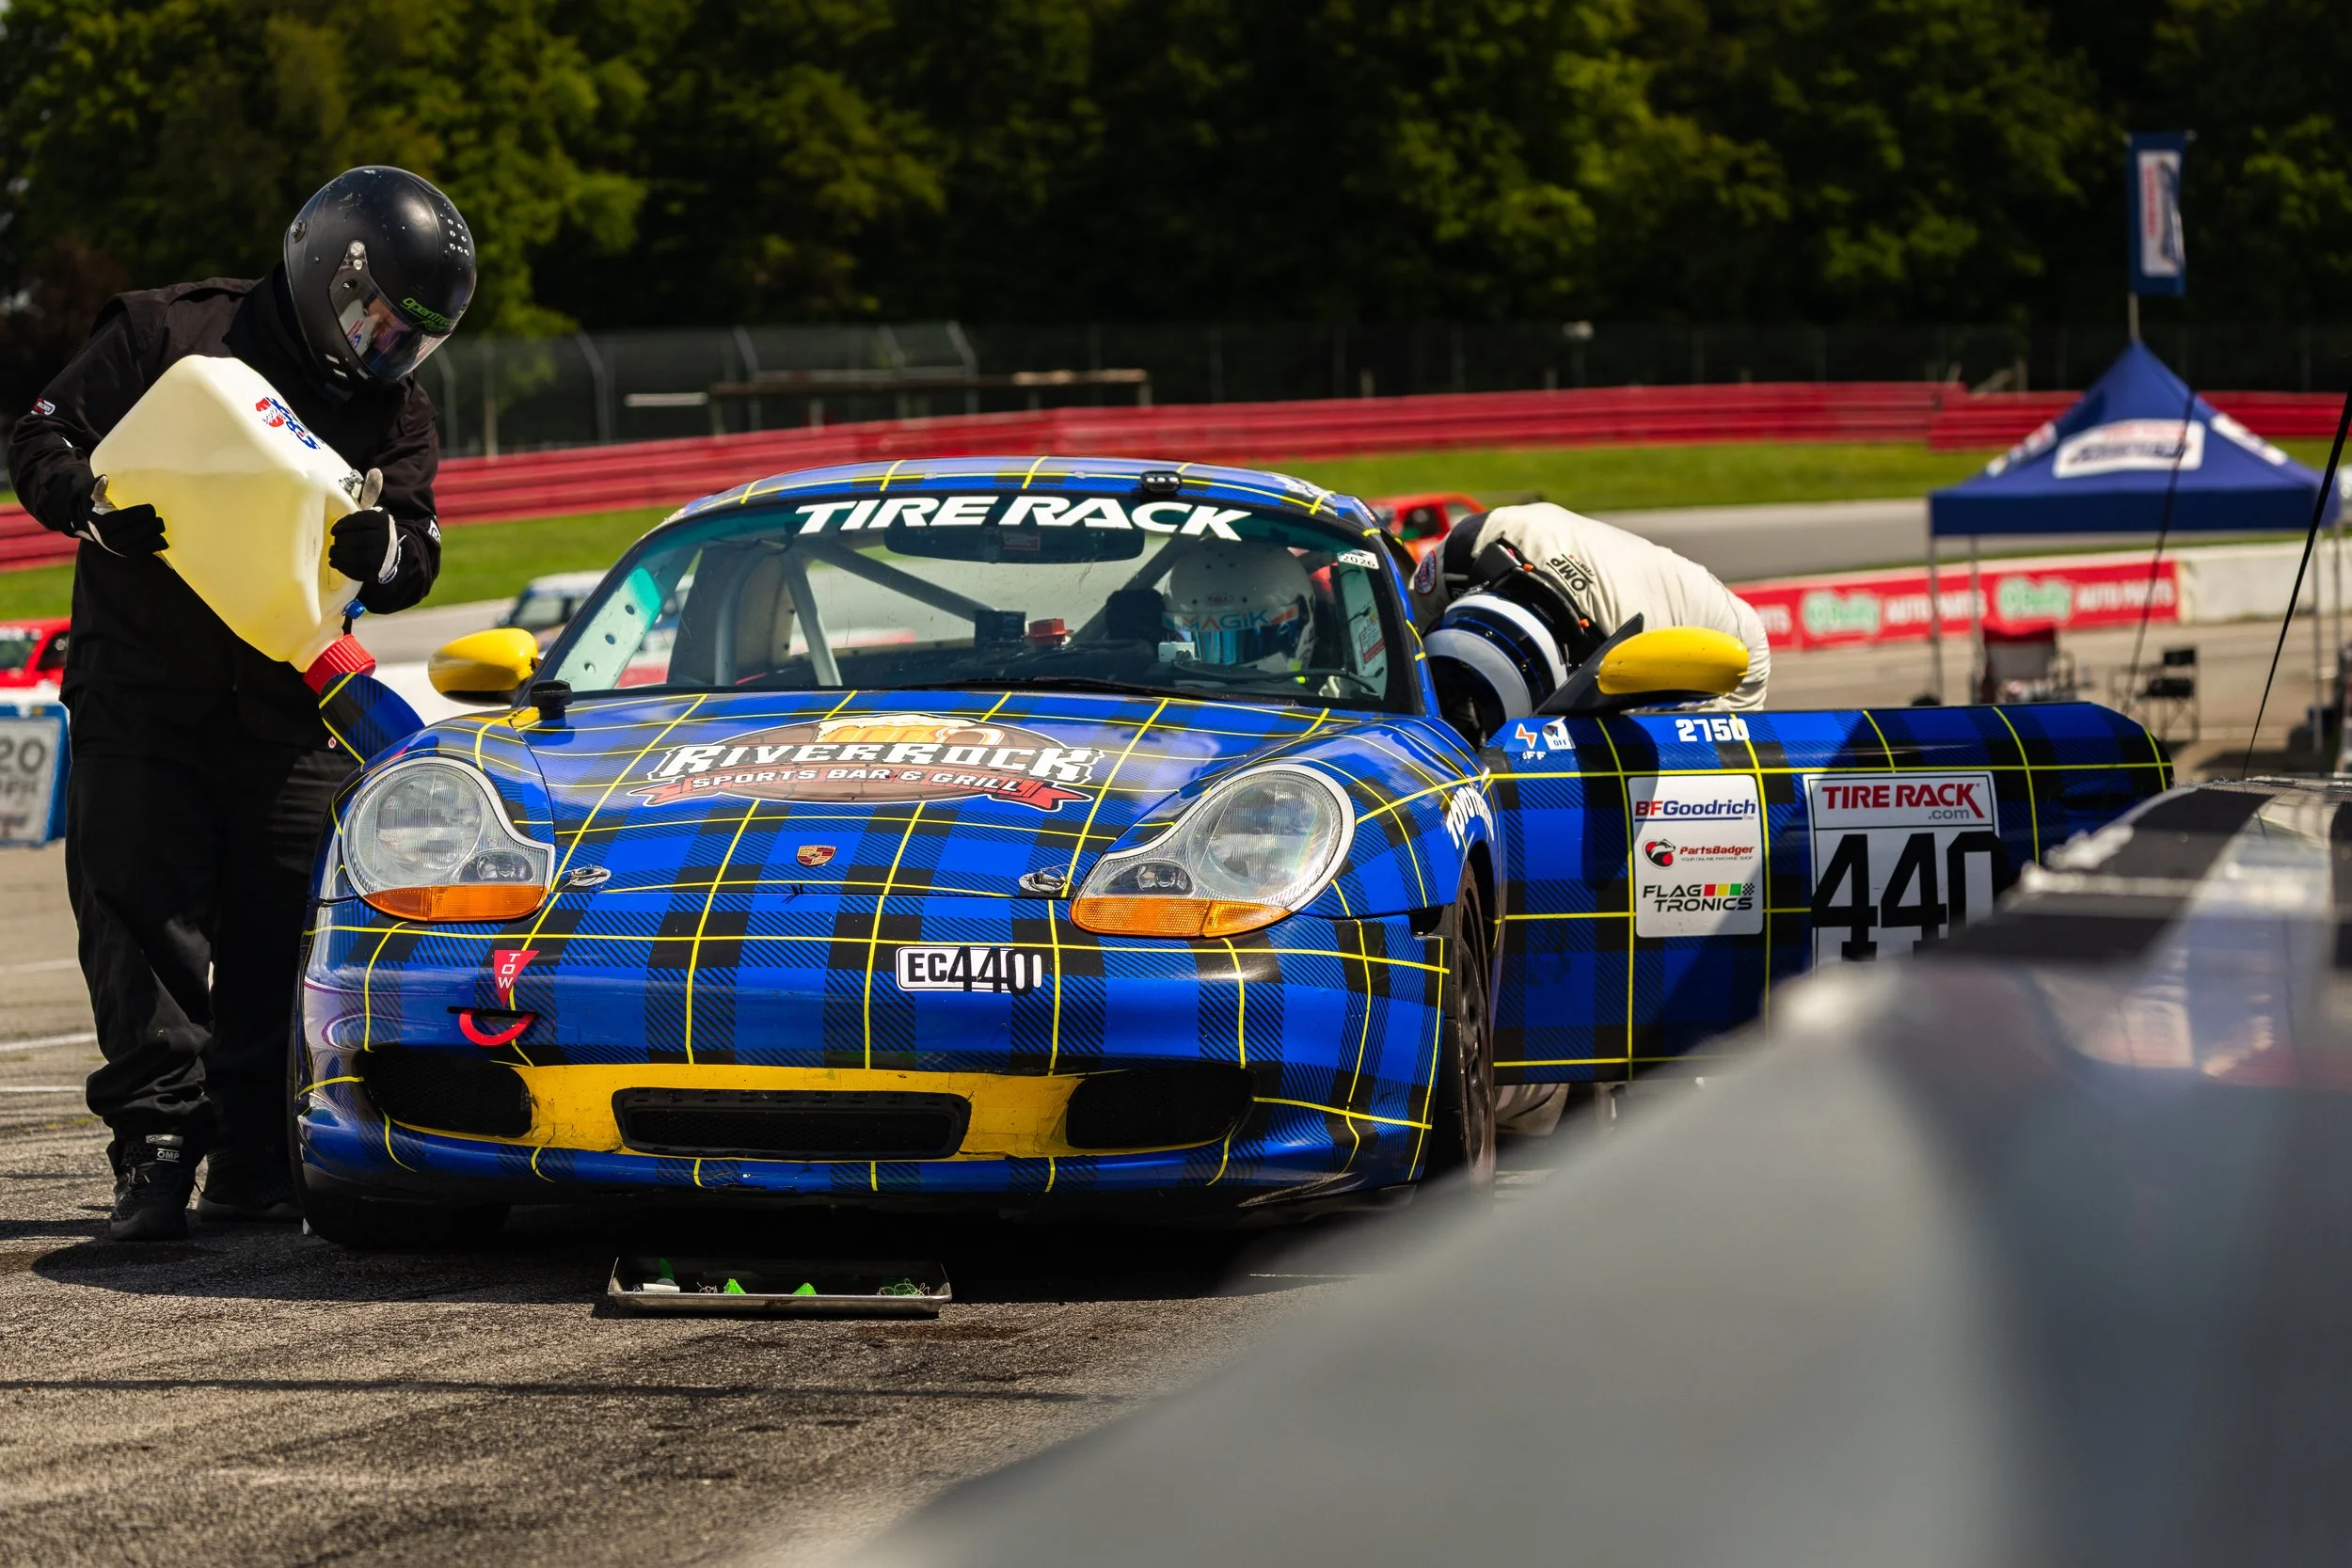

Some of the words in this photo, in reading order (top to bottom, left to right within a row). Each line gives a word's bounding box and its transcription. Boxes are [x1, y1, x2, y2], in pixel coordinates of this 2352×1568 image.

[795, 496, 999, 534] TIRE
[999, 496, 1253, 541] RACK
[1343, 555, 1375, 567] 2026
[1550, 558, 1587, 592] OMP
[1676, 719, 1750, 742] 2750
[691, 769, 818, 789] SPORTS
[827, 768, 893, 780] BAR
[900, 770, 922, 782] &
[930, 772, 1022, 792] GRILL
[1635, 799, 1756, 817] BFGoodrich
[1821, 784, 1890, 810] TIRE
[1895, 783, 1985, 818] RACK
[1928, 809, 1970, 820] .com
[1679, 846, 1755, 857] PartsBadger
[1643, 883, 1702, 898] FLAG
[1811, 831, 2015, 961] 440
[1654, 896, 1753, 912] TRONICS
[498, 953, 521, 989] TOW
[157, 1150, 180, 1160] OMP
